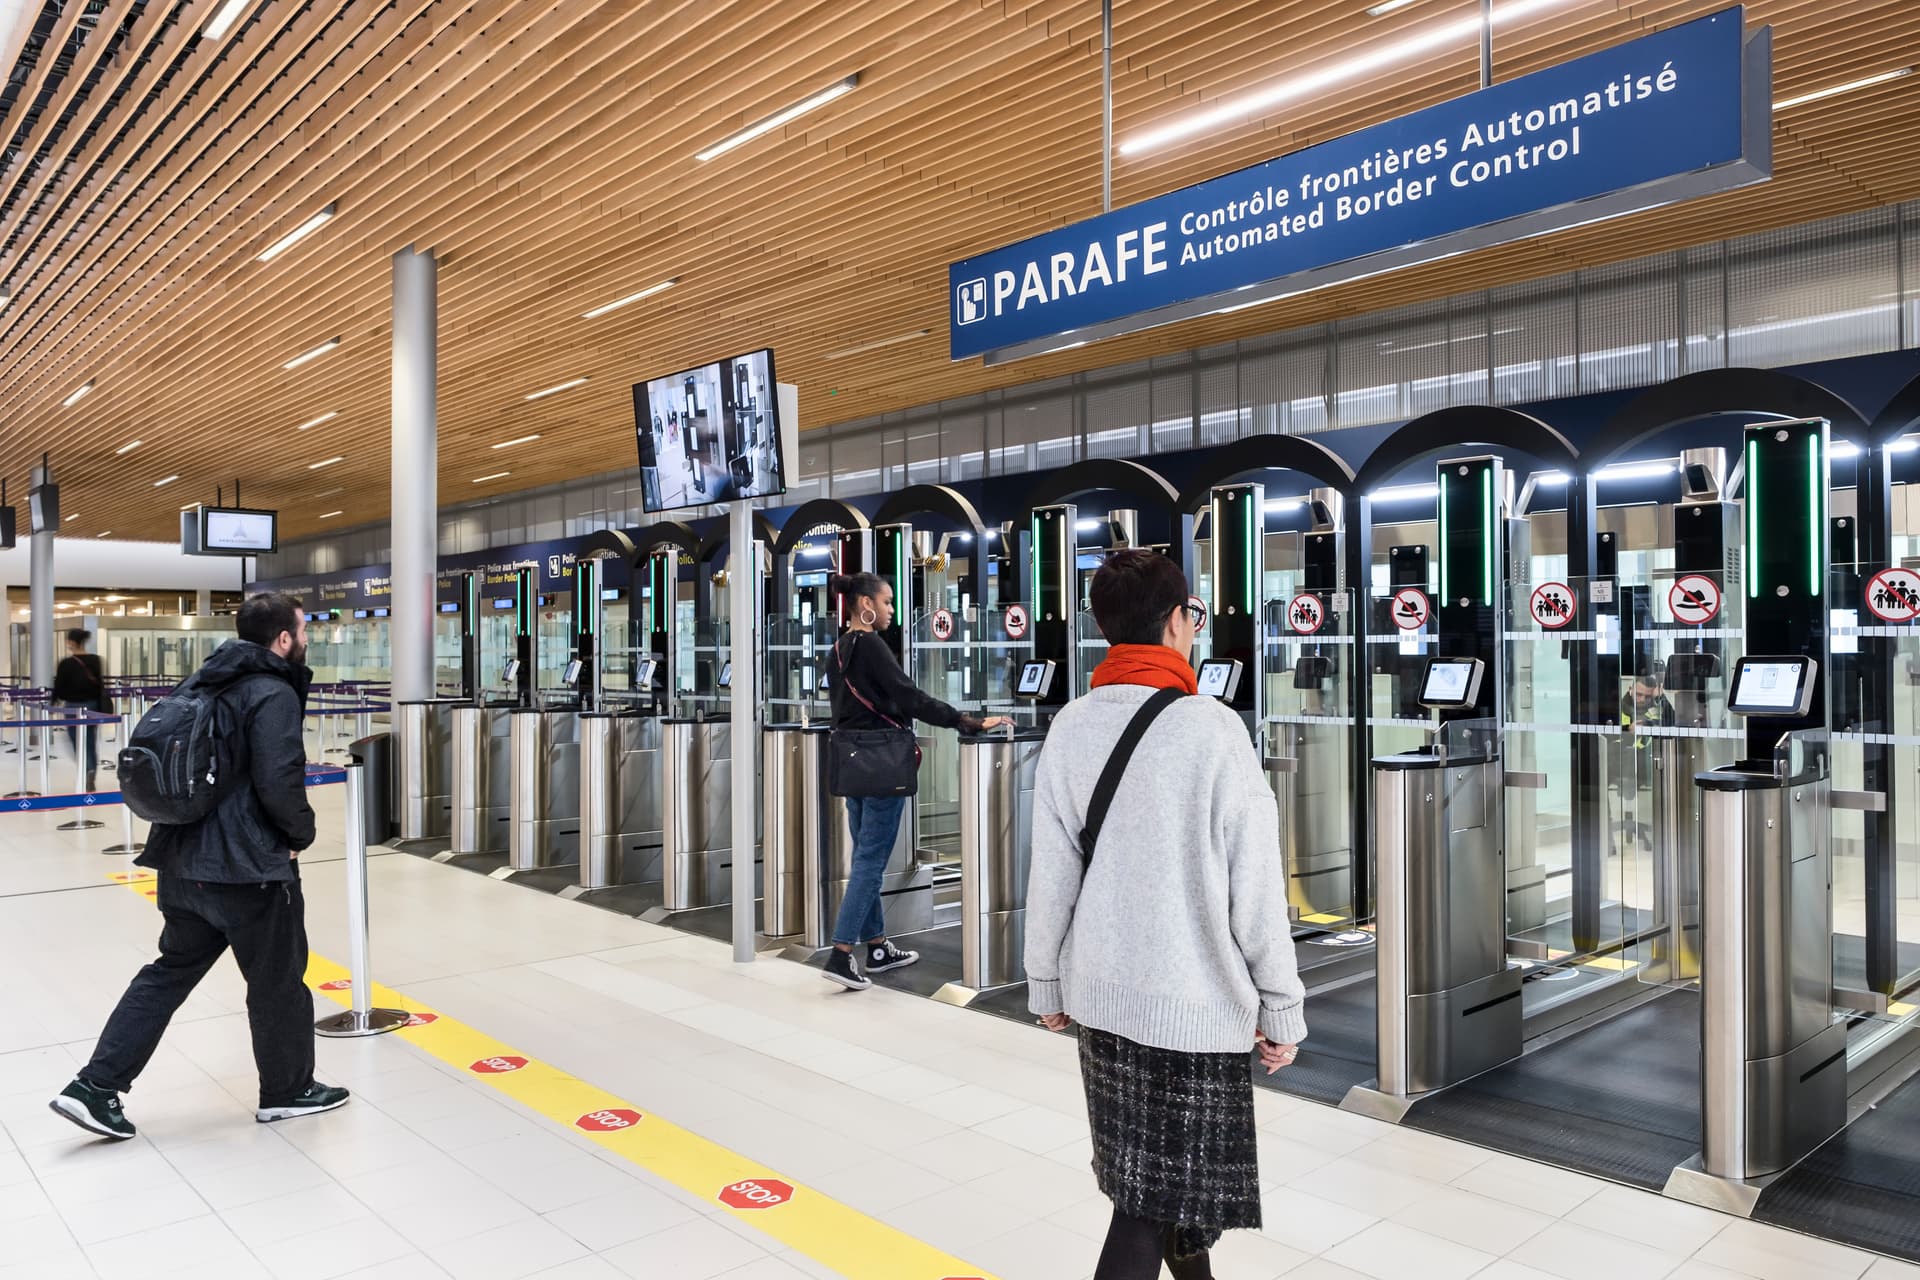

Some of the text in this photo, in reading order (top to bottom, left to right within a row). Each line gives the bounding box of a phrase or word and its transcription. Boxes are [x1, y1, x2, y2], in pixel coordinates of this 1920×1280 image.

[1180, 61, 1678, 235] Contrôle frontières Automatisé
[1180, 126, 1580, 266] Automated Border Control
[994, 222, 1168, 317] PARAFE
[481, 1057, 516, 1071] STOP
[588, 1110, 629, 1128] STOP
[730, 1181, 782, 1204] STOP
